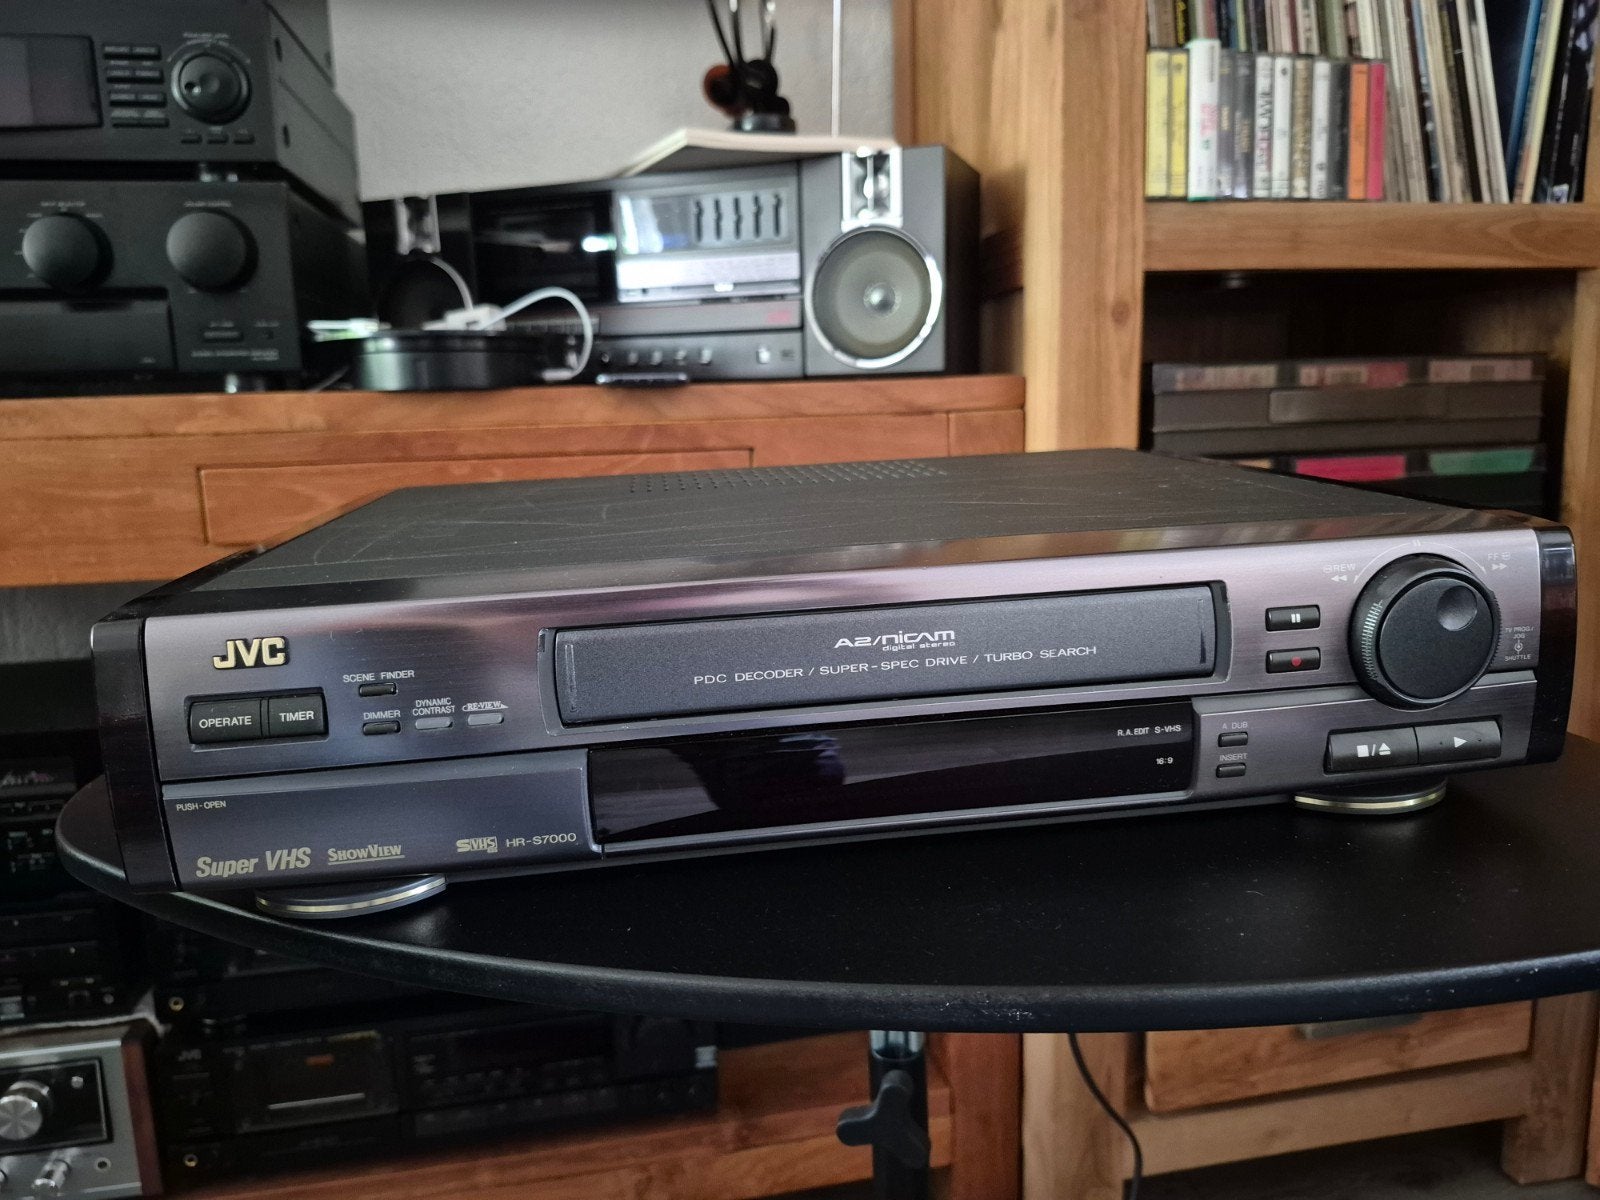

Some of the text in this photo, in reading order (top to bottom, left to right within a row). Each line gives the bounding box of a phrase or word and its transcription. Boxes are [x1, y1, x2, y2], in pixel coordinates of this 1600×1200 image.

[882, 640, 956, 652] digital stereo
[212, 636, 286, 669] JVC
[1504, 653, 1532, 661] SHUTTLE
[693, 674, 728, 685] PDC
[734, 668, 804, 682] DECODER
[925, 655, 968, 668] DRIVE
[984, 650, 1033, 662] TURBO
[1039, 645, 1097, 659] SEARCH
[342, 669, 415, 683] SCENE FINDER
[415, 697, 452, 708] DYNAMIC
[363, 710, 401, 720] DIMMER
[412, 705, 456, 716] CONTRAST
[198, 715, 252, 729] OPERATE
[279, 710, 315, 723] TIMER
[1154, 724, 1182, 734] S-VHS
[1222, 721, 1248, 730] A DUB
[1156, 756, 1174, 765] 16:9
[1219, 752, 1248, 762] INSERT
[506, 832, 577, 848] HR-S7000
[196, 846, 312, 878] Super VHS
